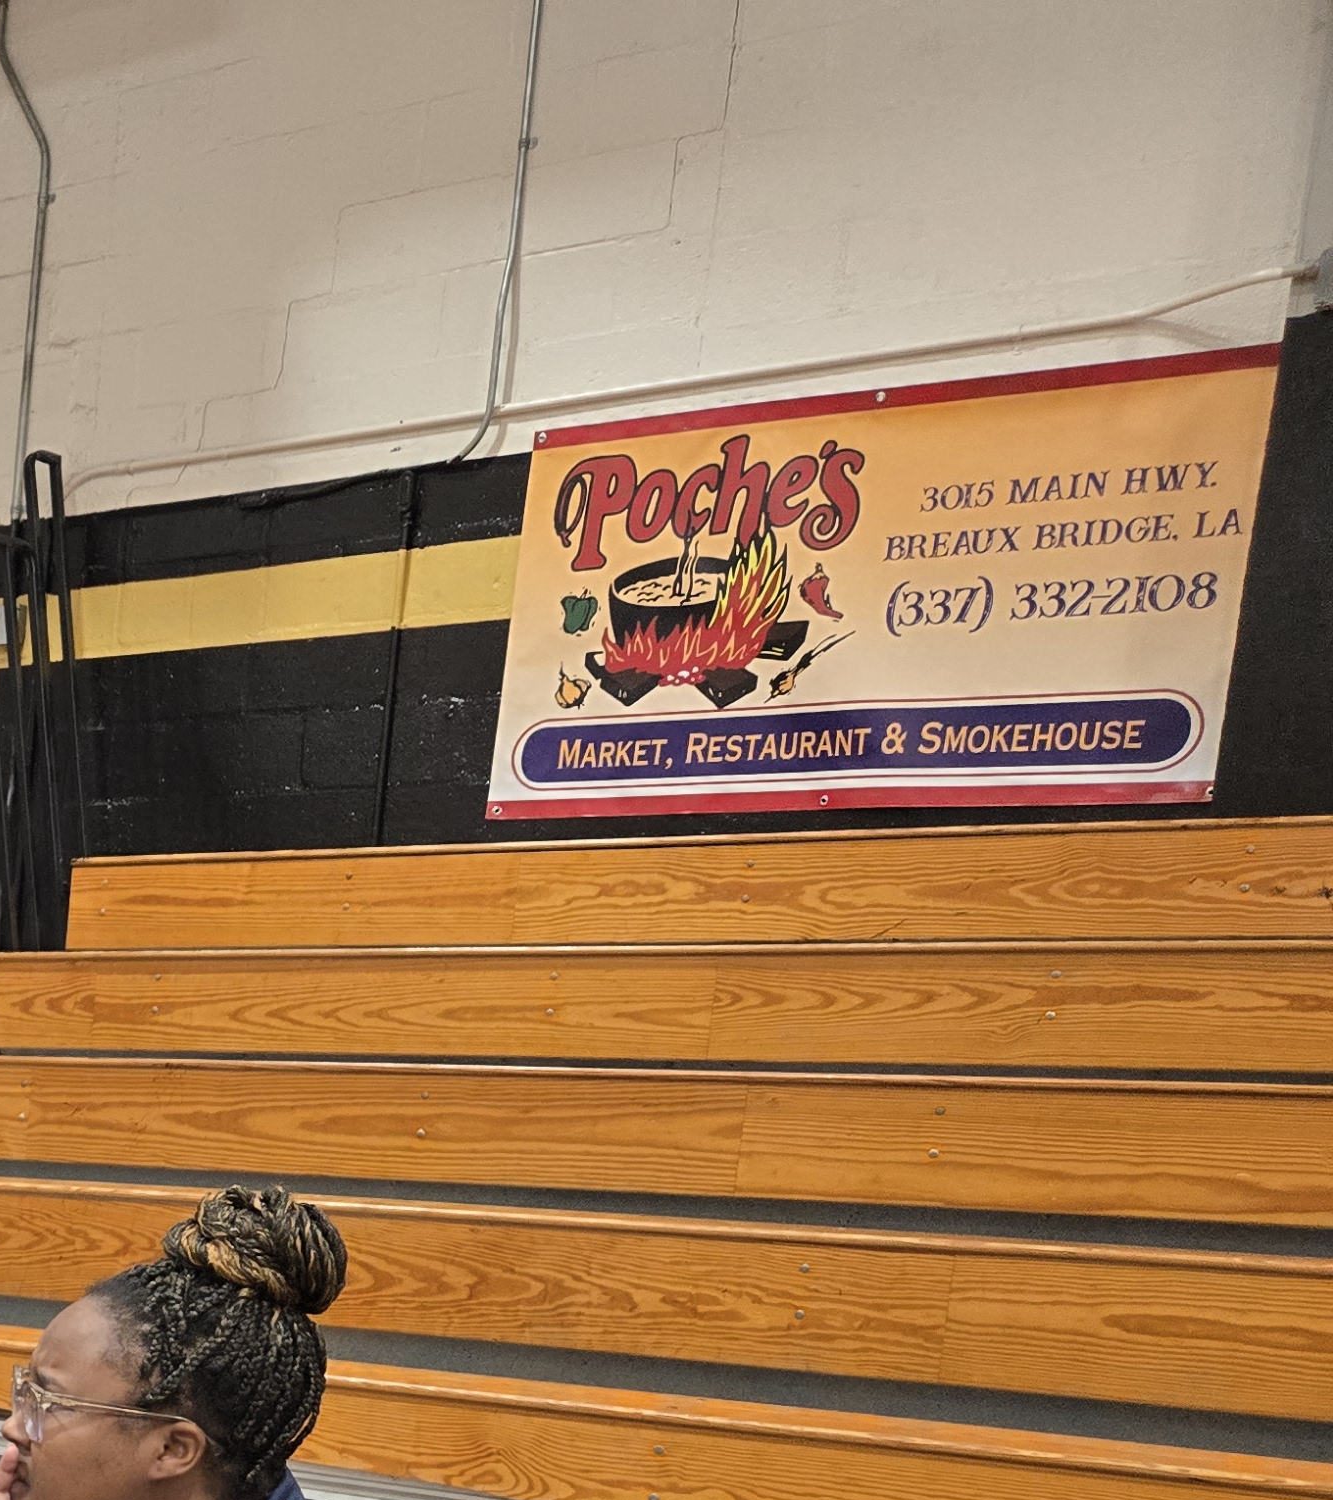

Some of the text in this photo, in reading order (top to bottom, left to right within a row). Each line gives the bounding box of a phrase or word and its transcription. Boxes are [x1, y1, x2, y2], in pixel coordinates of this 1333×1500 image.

[554, 434, 865, 571] Poche's
[919, 461, 1220, 513] 3015 MAIN HWY.
[883, 525, 1021, 562] BREAUX
[1192, 508, 1243, 539] LA
[885, 571, 1218, 637] (337) 332-2108
[557, 719, 1146, 770] MARKET, RESTAURANT & SMOKEHOUSE
